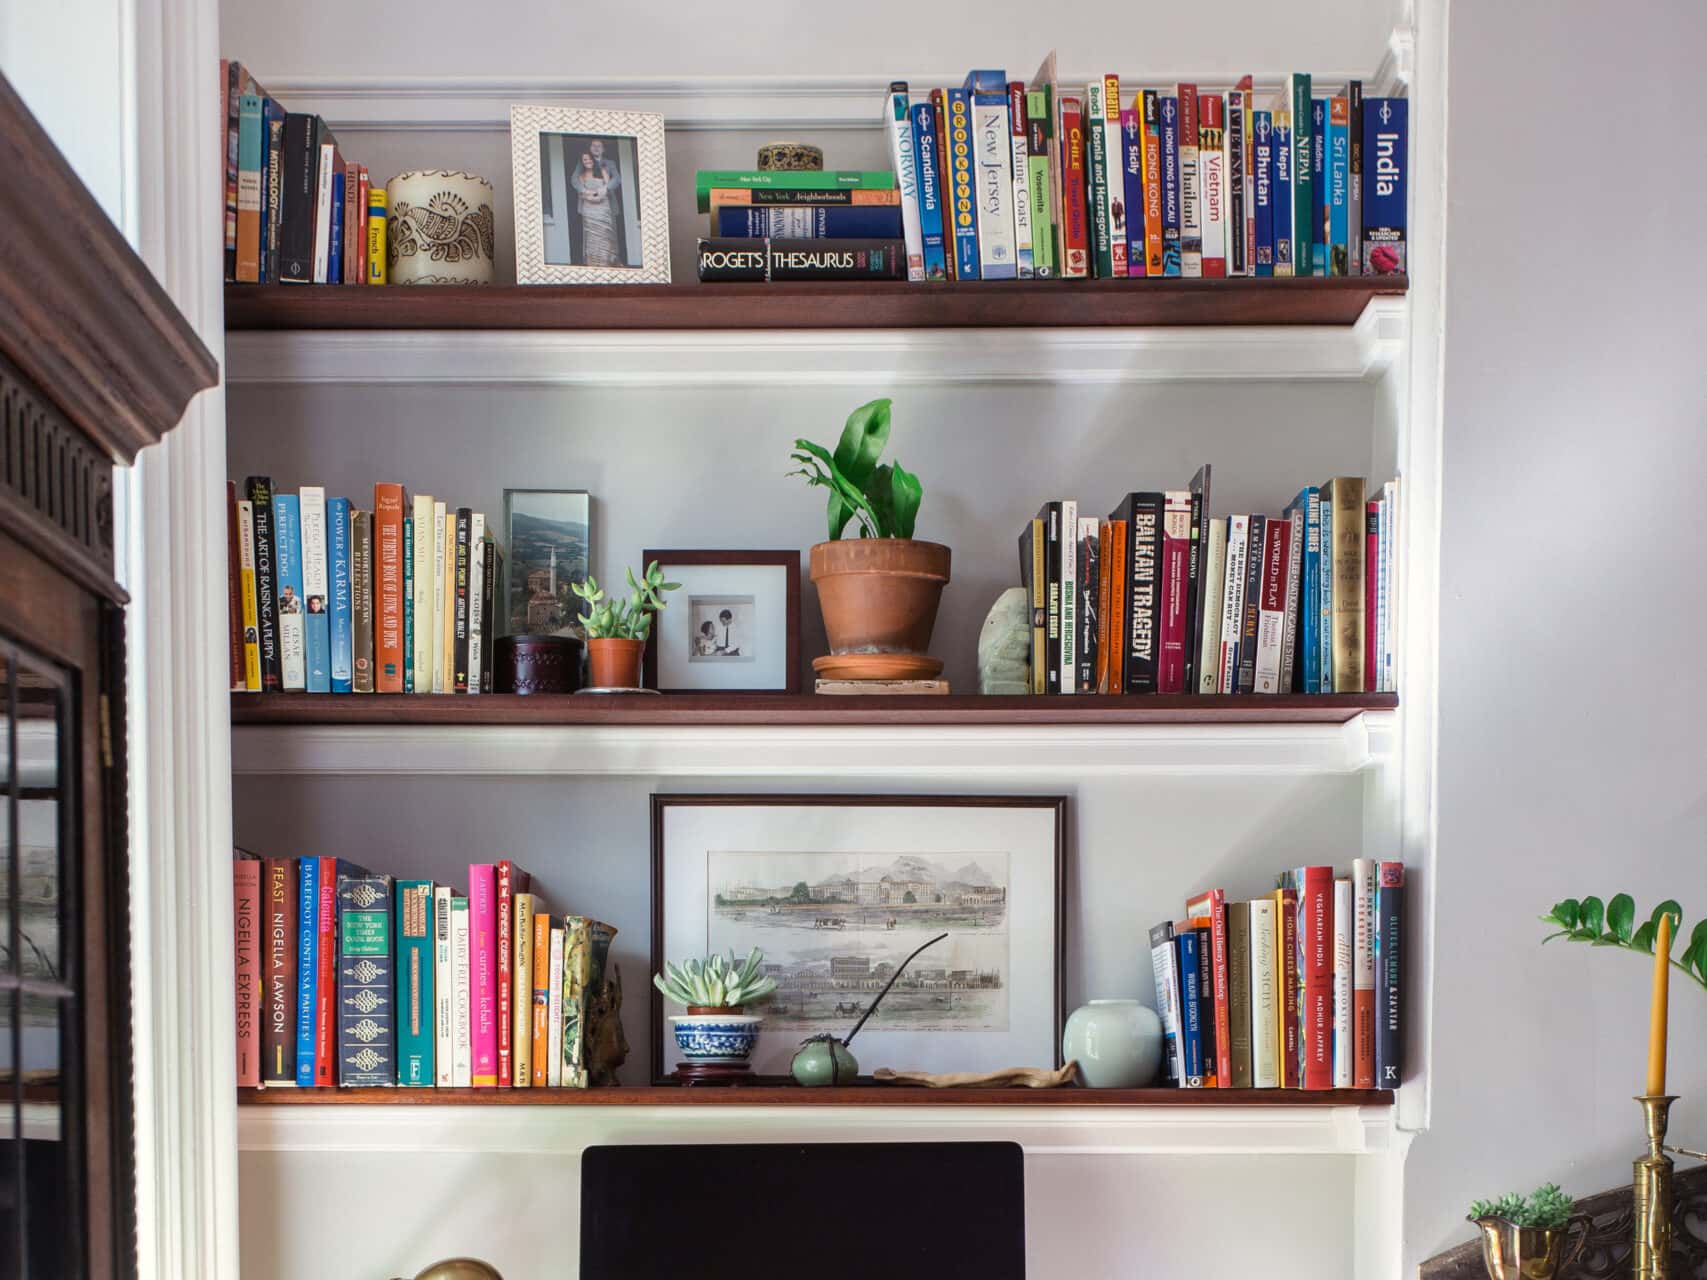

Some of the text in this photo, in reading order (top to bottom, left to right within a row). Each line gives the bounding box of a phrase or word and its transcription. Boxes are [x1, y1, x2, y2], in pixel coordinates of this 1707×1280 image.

[897, 126, 916, 199] NORWAY
[1070, 128, 1080, 170] CHILE
[1128, 145, 1139, 175] Sicily
[1166, 127, 1174, 154] HONG
[1230, 111, 1242, 196] VIETNAM
[1296, 135, 1310, 185] NEPAL
[269, 150, 279, 210] MYTHOLOGY
[921, 135, 937, 211] Scandinavia
[981, 115, 1002, 217] New Jersey
[1015, 140, 1029, 227] Maine Coast
[1148, 143, 1161, 217] HONG KONG
[1167, 155, 1175, 181] KONG
[1257, 146, 1271, 206] Bhutan
[1277, 146, 1289, 181] Nepal
[1333, 137, 1345, 206] Sri Lanka
[1376, 132, 1399, 196] India
[1036, 169, 1044, 214] Yosemite
[1092, 125, 1108, 252] Bosnia and Herzegovina
[1167, 191, 1176, 223] MACAU
[1183, 159, 1198, 229] Thailand
[1209, 156, 1222, 223] Vietnam
[371, 227, 380, 255] French
[772, 252, 854, 268] THESAURUS
[256, 512, 267, 535] THE
[1308, 492, 1320, 525] TAKING
[258, 535, 268, 557] ART
[278, 503, 289, 577] PERFECT DOG
[335, 512, 346, 612] POWER KARMA
[1249, 522, 1260, 583] ARMSTRONG
[1271, 540, 1281, 576] WORLD
[1308, 526, 1320, 553] SIDES
[259, 557, 269, 574] OF
[383, 524, 397, 649] THE TIBETAN BOOK OF LIVING AND DYING
[457, 518, 466, 639] THE WAY AND ITS POWER ARTHUR WALEY
[1132, 513, 1155, 662] BALKAN TRAGEDY
[1229, 553, 1237, 583] MONEY
[260, 575, 271, 617] RAISING
[1064, 580, 1073, 606] BOSNIA
[1064, 607, 1073, 620] AND
[1233, 583, 1243, 636] DEMOCRACY
[1269, 583, 1278, 608] FLAT
[1289, 580, 1299, 611] NATION
[263, 627, 275, 661] PUPPY
[1063, 621, 1073, 666] HERCEGOVINA
[1286, 612, 1297, 647] AGAINST
[1284, 649, 1293, 672] STATE
[304, 864, 313, 928] BAREFOOT
[320, 885, 333, 933] Calcutta
[1315, 893, 1323, 942] VEGETARIAN
[273, 866, 285, 1033] FEAST NIGELLA LAWSON
[1215, 937, 1224, 963] History
[1216, 921, 1224, 936] Oral
[1389, 916, 1398, 949] OLIVES,
[237, 898, 250, 1039] NIGELLA EXPRESS
[303, 930, 312, 990] CONTESSA
[479, 877, 491, 1034] JAFFREY curries kebabs
[1287, 943, 1295, 977] CHEESE
[1217, 964, 1226, 1000] Workshop
[1262, 970, 1271, 1010] SICILY
[1288, 978, 1296, 1013] MAKING
[1337, 932, 1350, 1033] edible BROOKLYN
[457, 989, 469, 1049] COOKBOOK
[1316, 995, 1324, 1063] MADHUR JAFFREY
[1389, 994, 1398, 1031] ZA'ATAR
[1384, 1065, 1397, 1080] K
